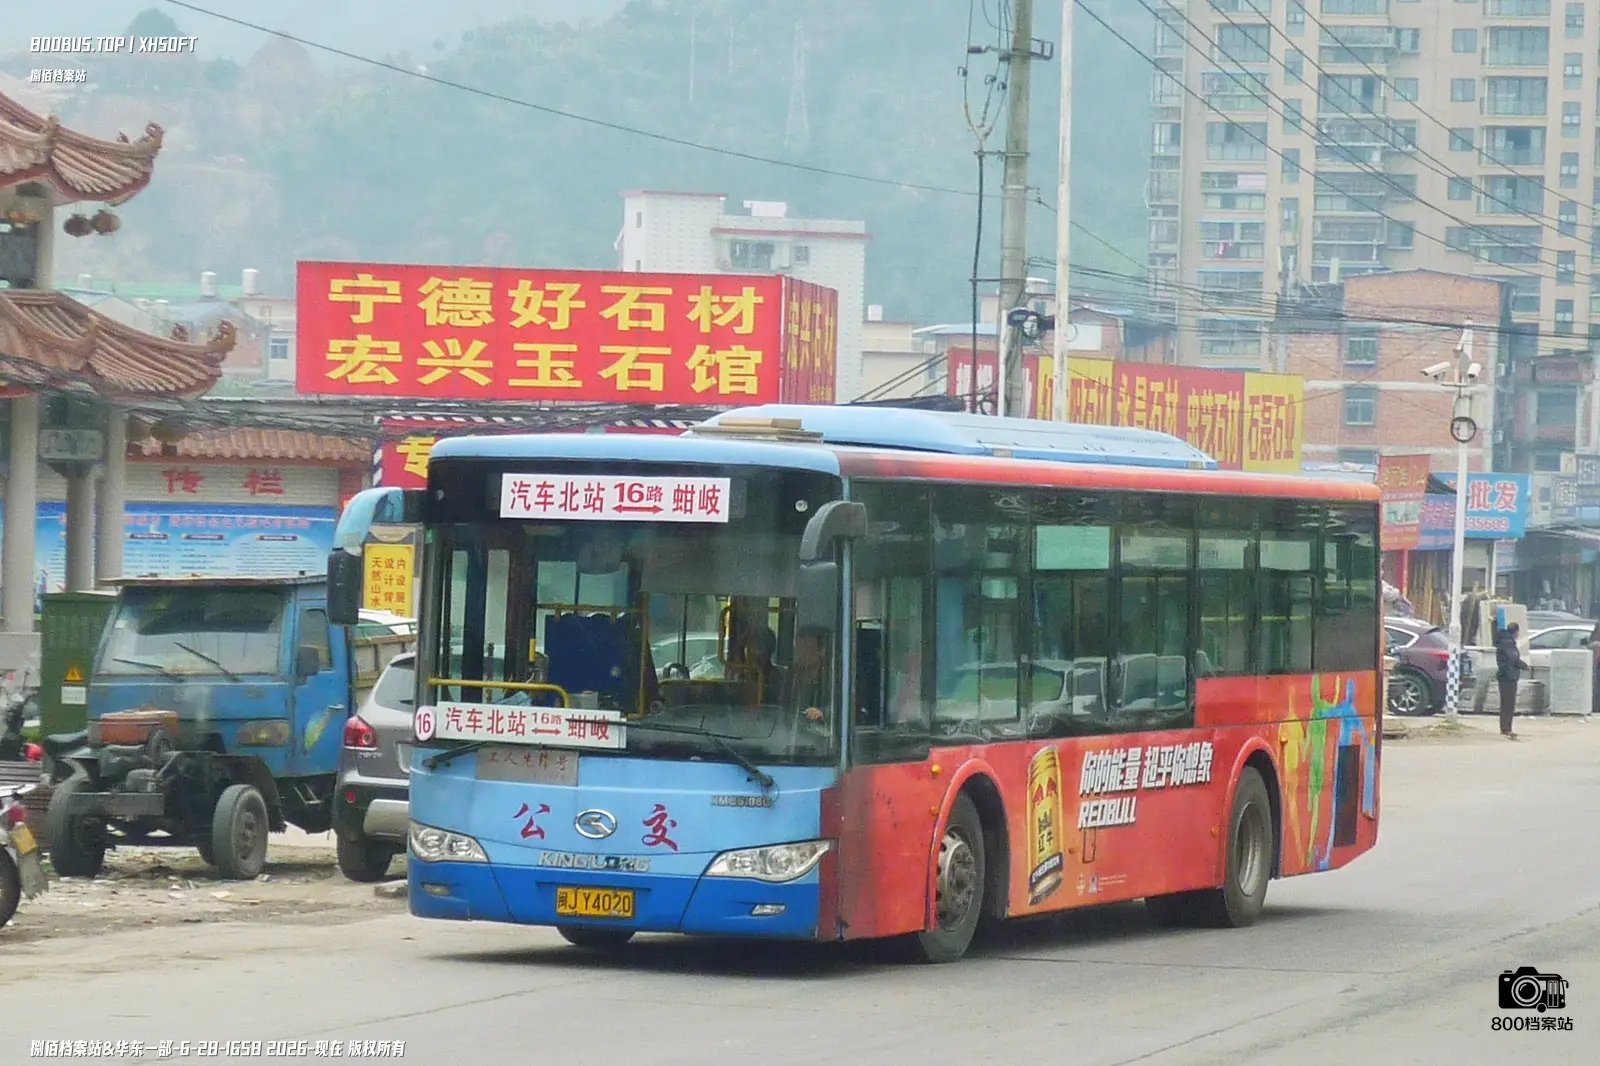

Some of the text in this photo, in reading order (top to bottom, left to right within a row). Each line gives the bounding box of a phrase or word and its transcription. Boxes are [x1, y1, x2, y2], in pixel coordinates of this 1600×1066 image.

[328, 272, 764, 335] 宁德好石材
[325, 333, 764, 395] 宏兴玉石馆
[396, 436, 435, 479] 专
[510, 480, 721, 515] 汽车北站 16路 蚶岐
[1446, 480, 1518, 512] 批发
[416, 713, 431, 734] 16
[445, 706, 610, 740] 汽车北站 16路 蚶岐
[1079, 741, 1214, 796] 你的能量 超乎你想象
[514, 803, 679, 851] 公 交
[1077, 797, 1137, 829] REDBULL
